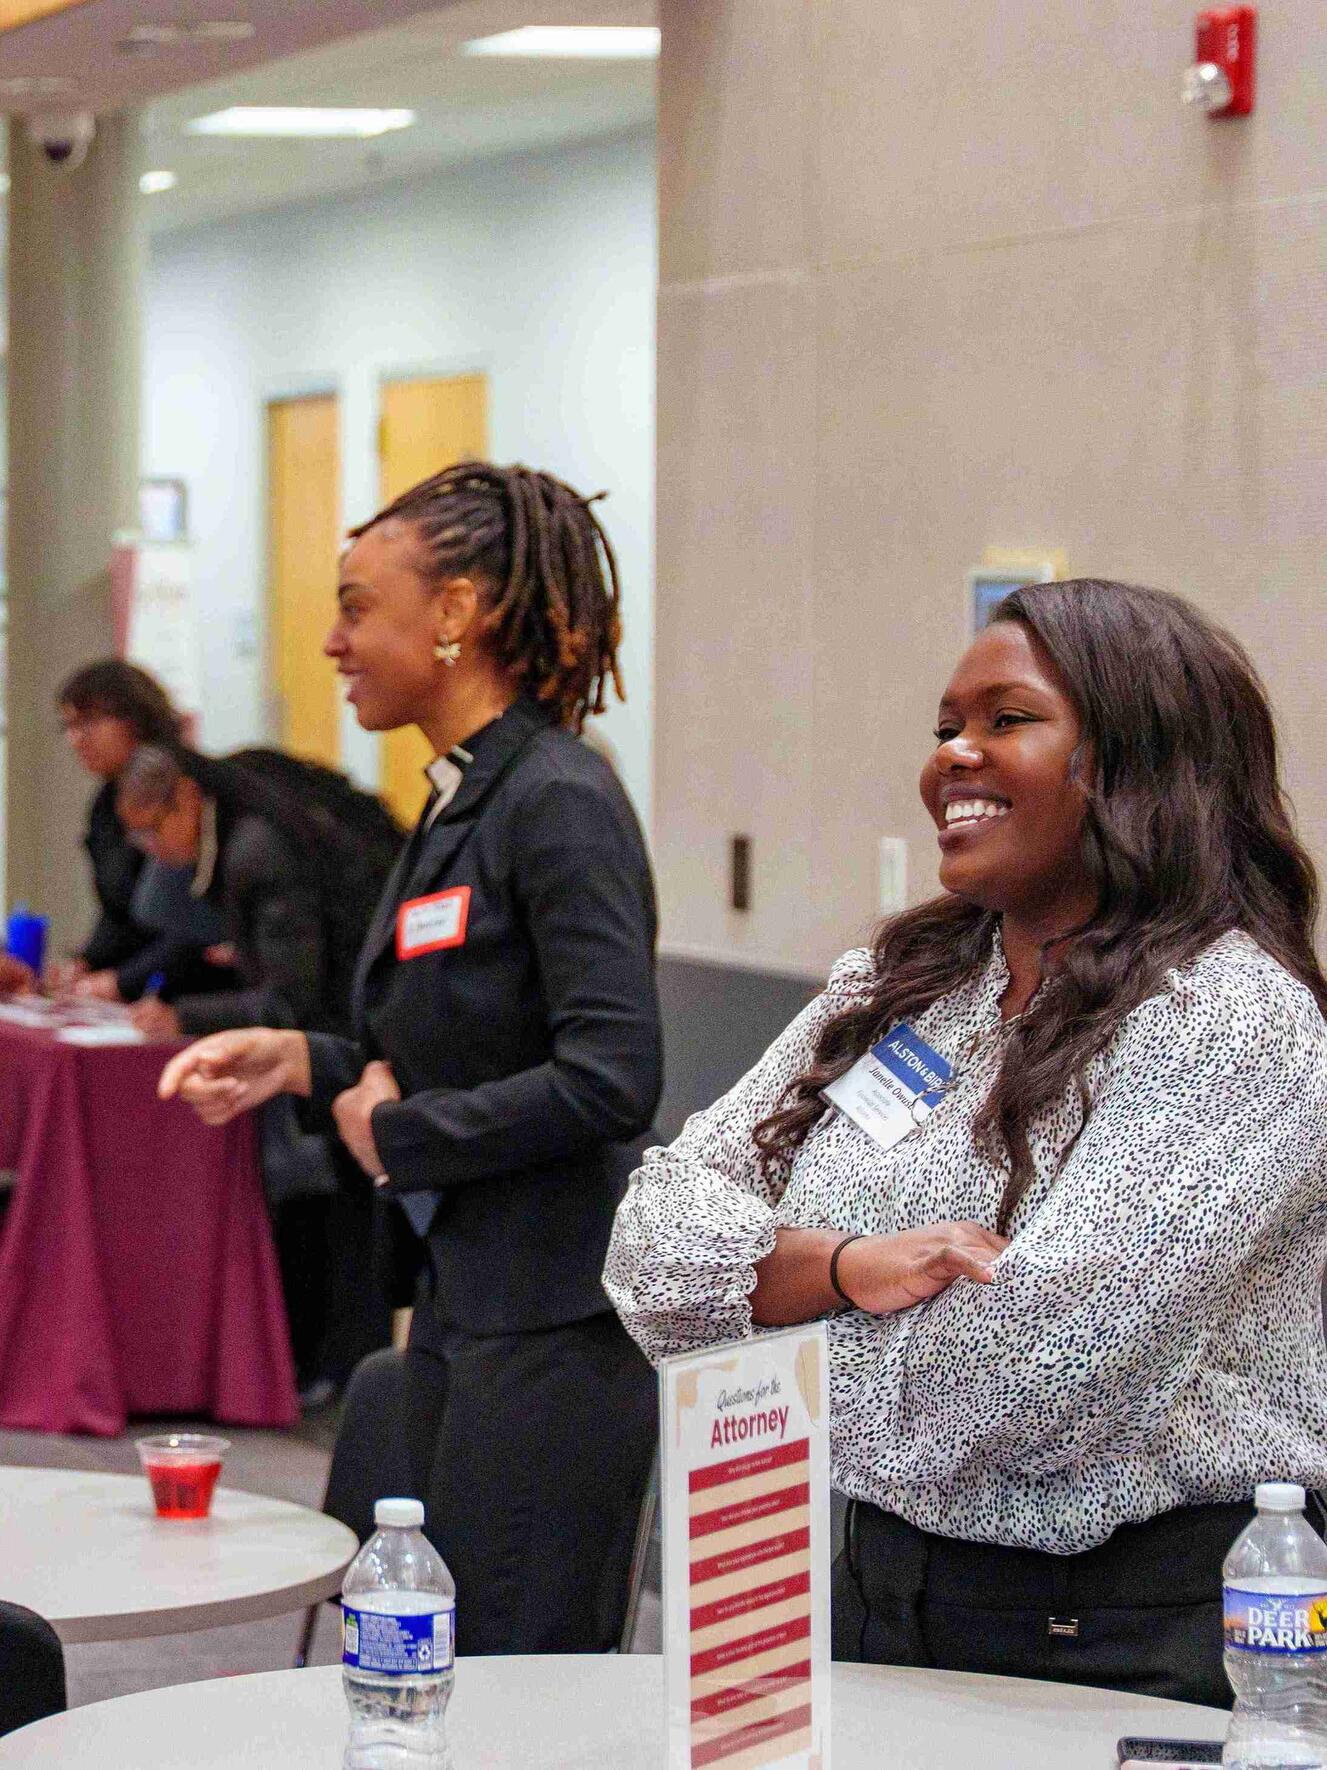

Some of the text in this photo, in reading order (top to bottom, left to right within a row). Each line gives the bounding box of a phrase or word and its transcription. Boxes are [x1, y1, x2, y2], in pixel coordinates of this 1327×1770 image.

[869, 1067, 895, 1091] Janelle
[717, 1375, 781, 1412] Questions for the
[711, 1405, 789, 1448] Attorney
[1247, 1607, 1309, 1628] DEER
[1247, 1626, 1312, 1650] PARK
